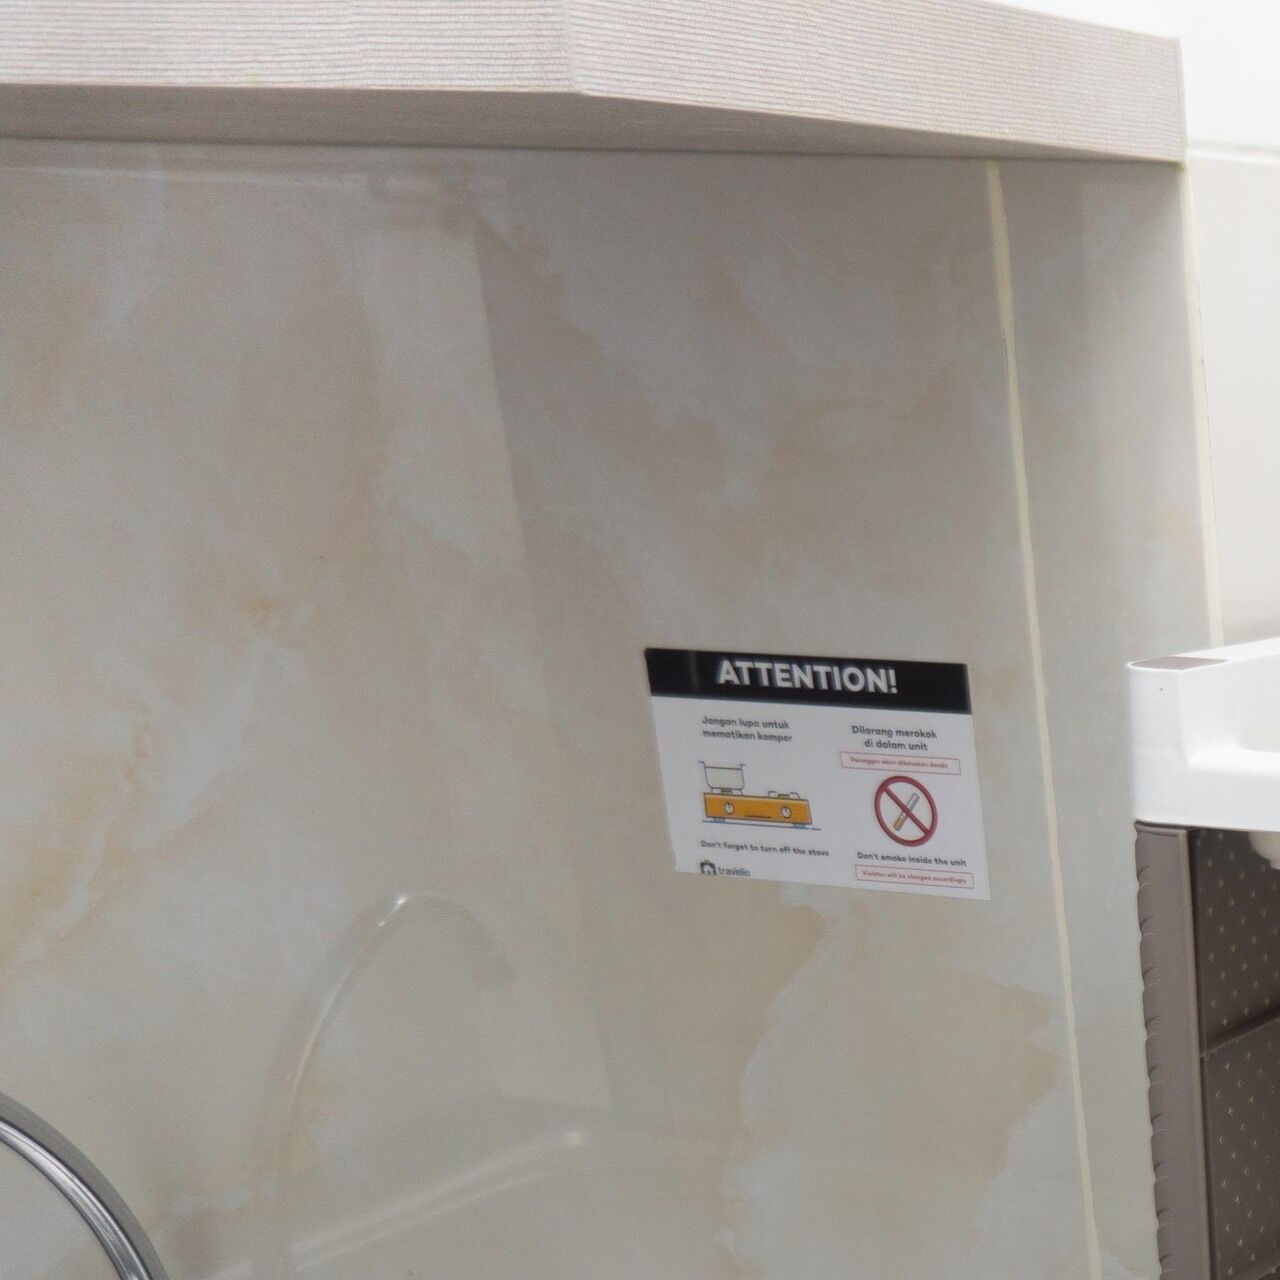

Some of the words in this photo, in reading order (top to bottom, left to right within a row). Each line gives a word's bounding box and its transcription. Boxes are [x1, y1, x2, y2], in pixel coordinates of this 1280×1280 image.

[718, 659, 898, 694] ATTENTION!
[702, 716, 737, 728] Jangan
[739, 718, 760, 729] lupa
[761, 719, 790, 729] untuk
[702, 729, 756, 741] mematikan
[852, 725, 893, 738] Dilarang
[895, 728, 938, 739] merokok
[864, 739, 874, 748] di
[876, 739, 907, 750] dalam
[908, 741, 928, 751] unit
[700, 840, 721, 849] Don't
[723, 841, 748, 852] forget
[760, 845, 778, 853] turn
[779, 846, 791, 854] off
[792, 847, 806, 855] the
[857, 852, 879, 861] Don't
[881, 854, 907, 862] smoke
[908, 855, 932, 864] inside
[934, 858, 948, 866] the
[950, 858, 967, 867] unit
